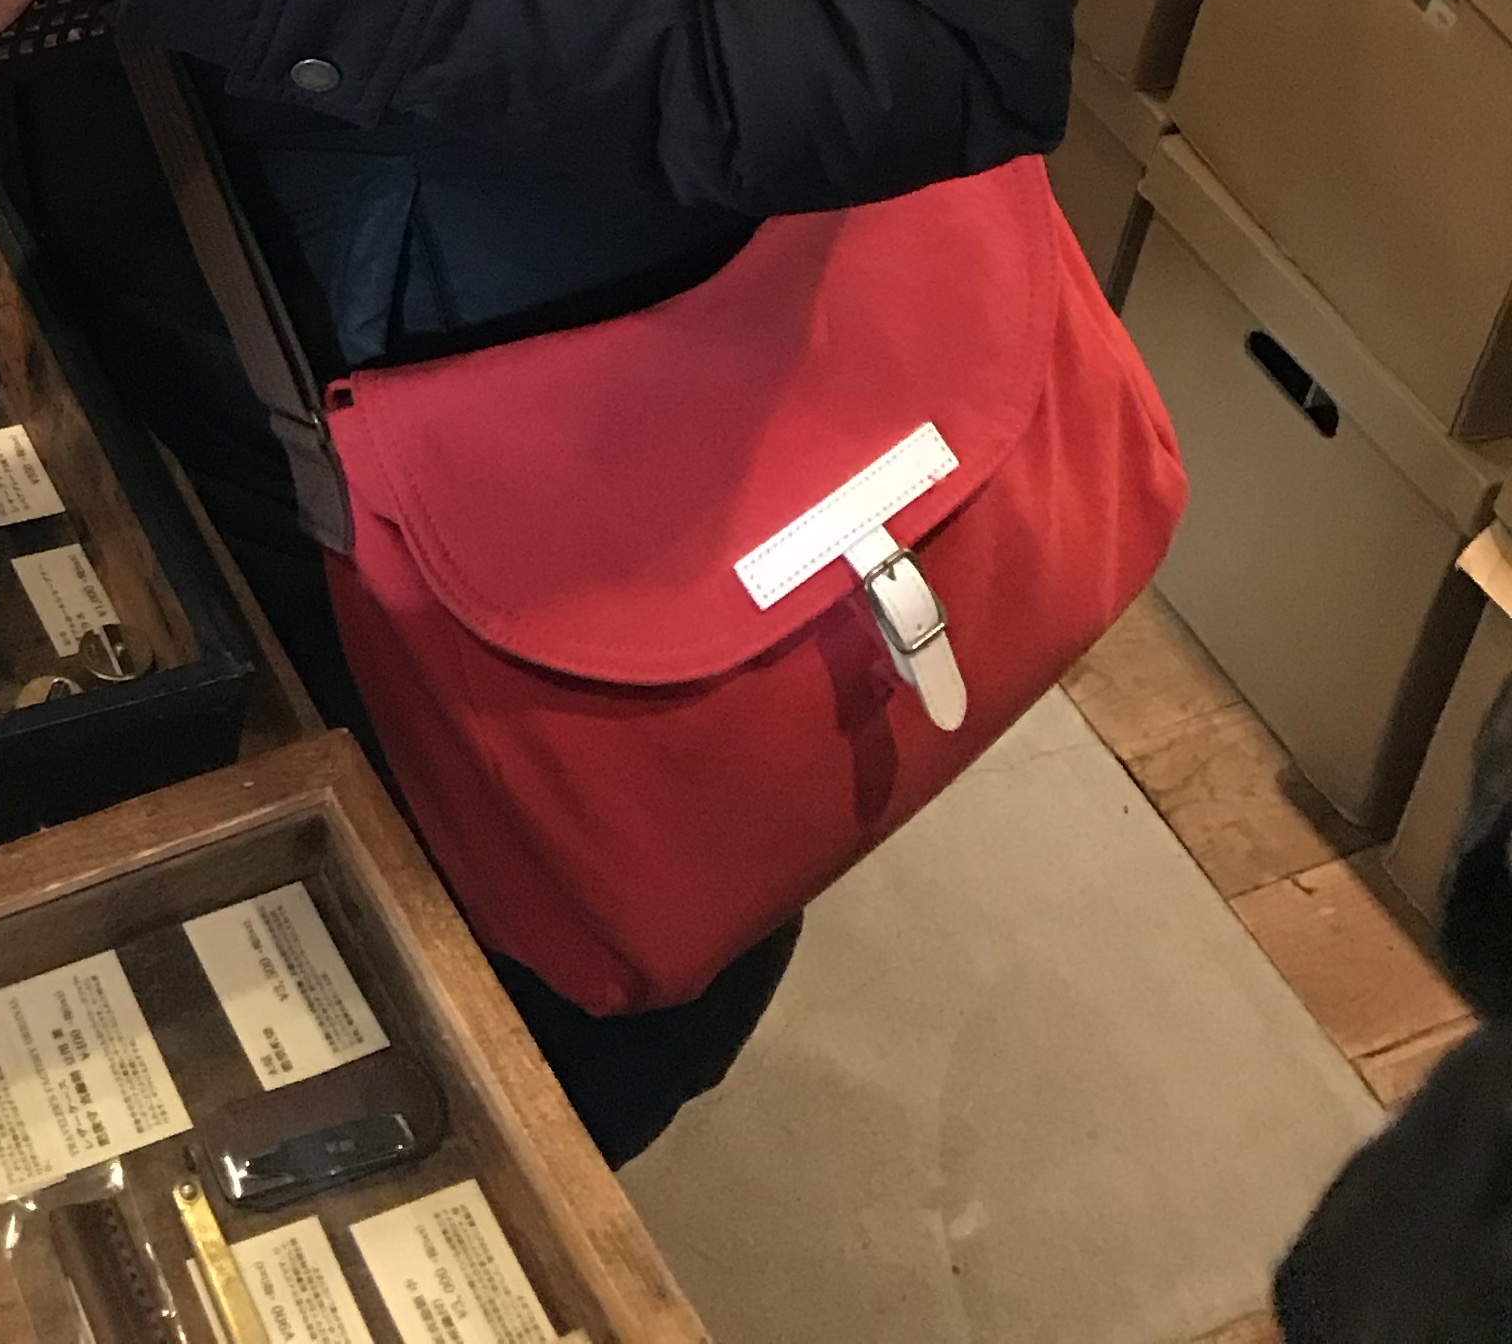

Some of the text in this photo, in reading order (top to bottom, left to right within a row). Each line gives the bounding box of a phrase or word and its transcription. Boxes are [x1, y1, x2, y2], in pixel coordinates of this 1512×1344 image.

[6, 996, 82, 1157] TRAVELER'S FACTORY ORIGINAL
[55, 1078, 95, 1150] レザーケース
[268, 1303, 296, 1342] ¥900
[433, 1265, 470, 1319] ¥3,000
